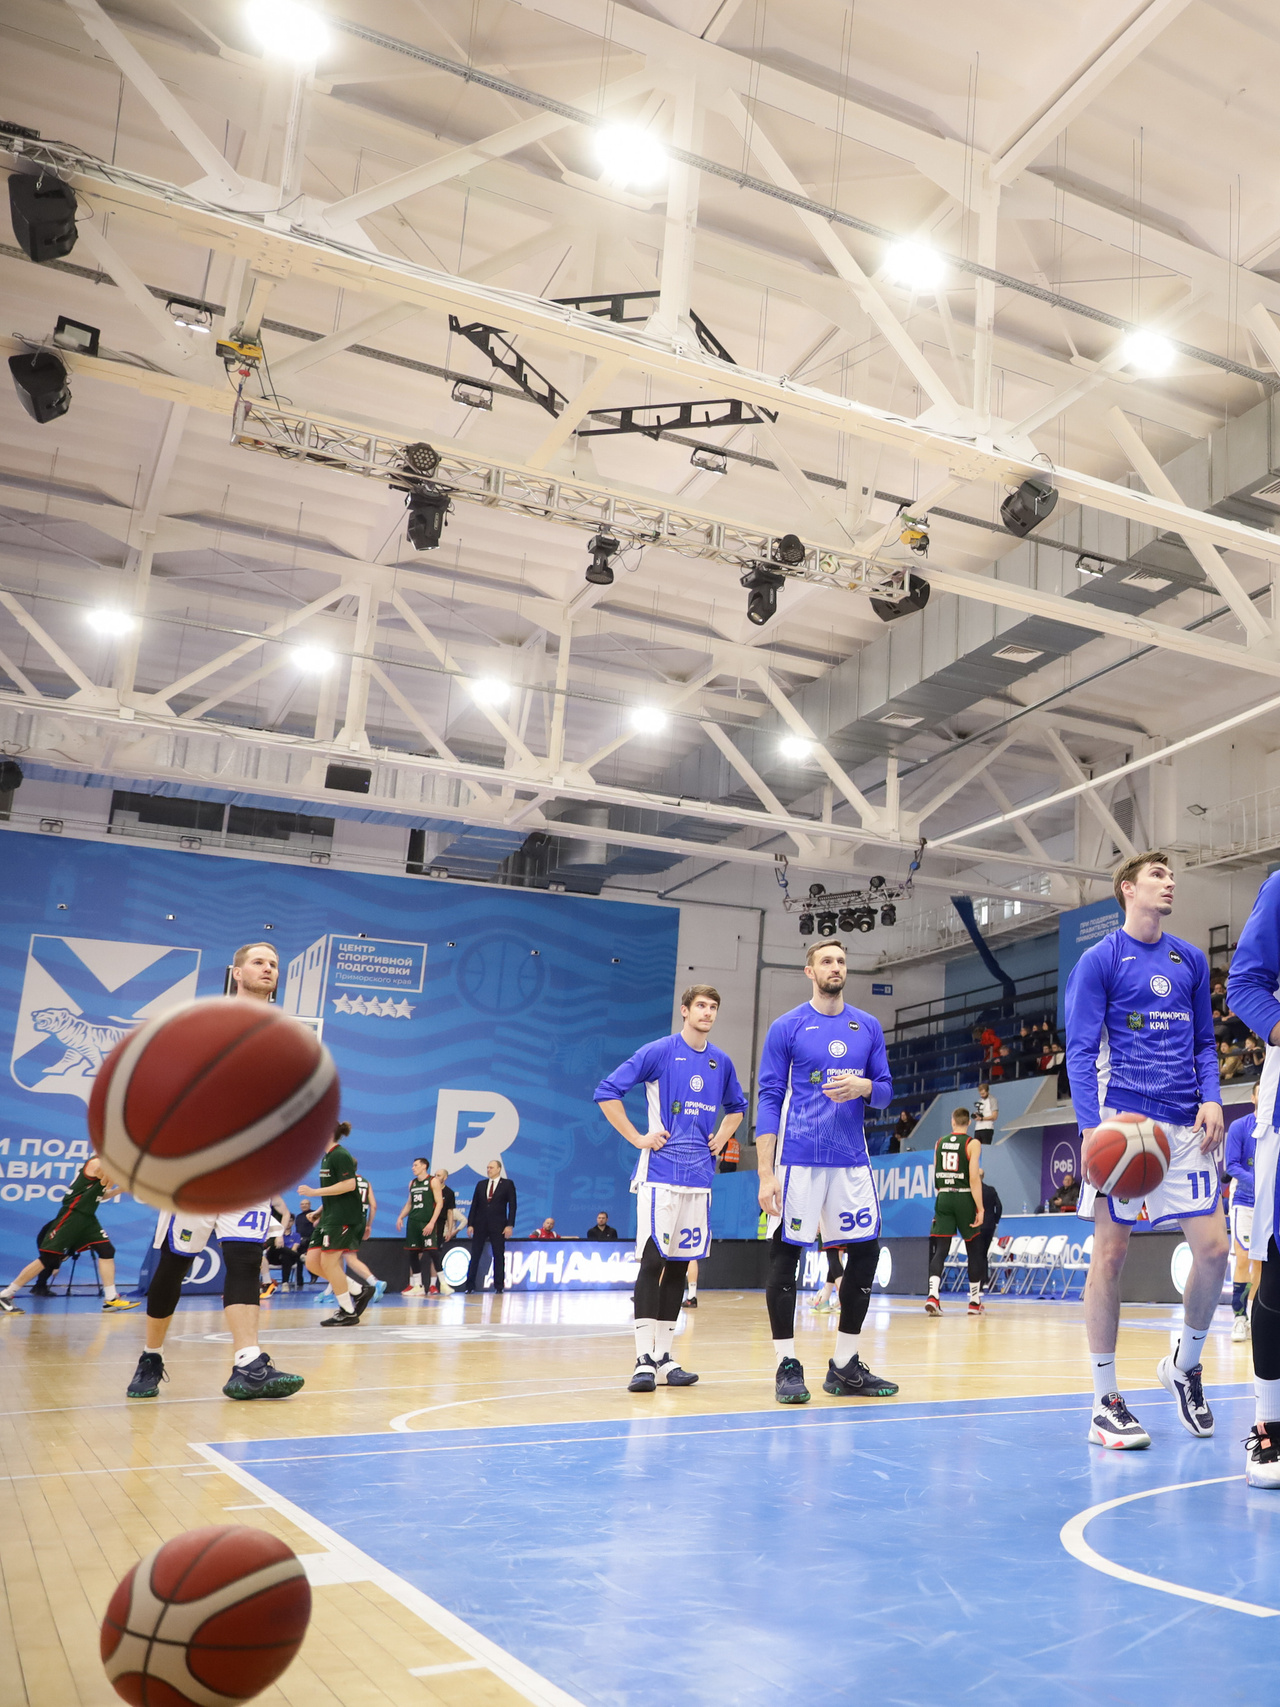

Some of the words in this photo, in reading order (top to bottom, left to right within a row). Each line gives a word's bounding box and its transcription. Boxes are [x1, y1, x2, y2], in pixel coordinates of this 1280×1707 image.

[339, 943, 376, 953] ЦЕНТР
[337, 952, 413, 967] СПОРТИВНОЙ
[336, 962, 411, 976] ПОДГОТОВКИ
[335, 972, 392, 983] Приморского
[392, 978, 412, 986] края
[1149, 1011, 1191, 1022] ПРИМОРСКИЙ
[1149, 1020, 1169, 1030] КРАЙ
[941, 1151, 959, 1171] 18
[1053, 1159, 1074, 1174] РФБ
[1186, 1170, 1212, 1200] 11
[237, 1210, 268, 1233] 41
[838, 1207, 873, 1232] 36
[678, 1226, 702, 1250] 29
